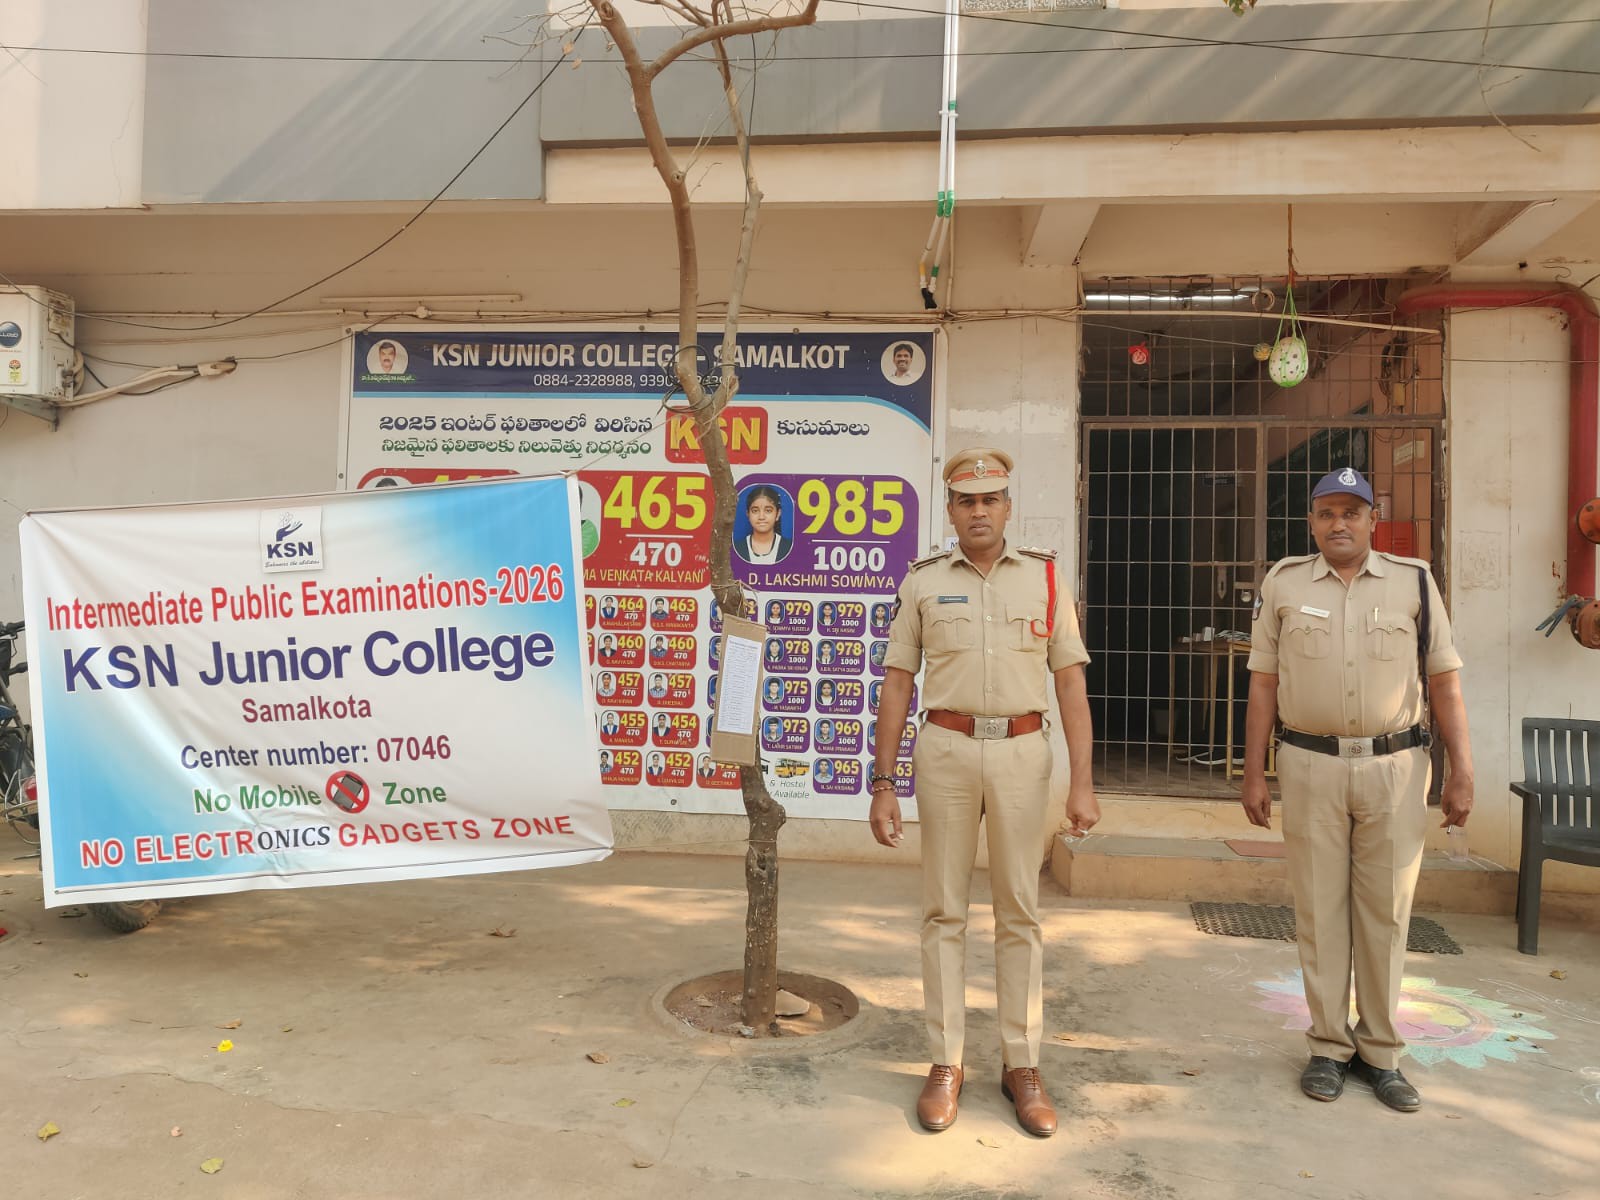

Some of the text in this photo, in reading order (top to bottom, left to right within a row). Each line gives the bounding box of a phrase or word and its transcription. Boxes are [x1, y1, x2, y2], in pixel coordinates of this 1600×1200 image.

[432, 343, 480, 367] KSN
[486, 344, 575, 367] JUNIOR
[582, 344, 680, 367] COLLEG
[533, 374, 636, 389] 0884-2328988,
[379, 415, 437, 432] 2025
[440, 413, 498, 431] ఇంటర్
[776, 419, 870, 436] కుసుమాలు
[603, 475, 707, 531] 465
[797, 478, 905, 536] 985
[266, 541, 314, 559] KSN
[629, 541, 682, 567] 470
[813, 546, 886, 572] 1000
[600, 568, 652, 582] VENKATA
[655, 569, 704, 584] KALYANI
[748, 572, 896, 589] D. LAKSHMI SOWMYA
[47, 564, 563, 631] Intermediate Public Examinations-2026
[618, 597, 644, 611] 464
[670, 598, 696, 612] 463
[624, 612, 638, 620] 470
[785, 601, 812, 616] 979
[837, 603, 863, 618] 979
[675, 614, 690, 622] 470
[617, 635, 644, 650] 460
[668, 636, 695, 650] 460
[785, 640, 810, 655] 978
[836, 641, 862, 656] 978
[63, 626, 555, 692] KSN Junior College
[622, 650, 637, 658] 470
[673, 652, 688, 660] 470
[618, 673, 641, 687] 457
[668, 674, 693, 689] 457
[784, 680, 808, 695] 975
[836, 682, 862, 697] 975
[241, 694, 373, 723] Samalkota
[620, 713, 646, 727] 455
[671, 714, 697, 729] 454
[783, 719, 808, 734] 973
[835, 721, 861, 736] 969
[180, 735, 452, 770] Center number: 07046
[614, 751, 640, 765] 452
[666, 753, 692, 768] 452
[834, 759, 859, 775] 965
[620, 767, 635, 775] 470
[671, 769, 685, 777] 470
[893, 762, 913, 778] 63
[193, 782, 448, 814] No Mobile Zone
[80, 816, 576, 868] NO ELECTRONICS GADGETS ZONE
